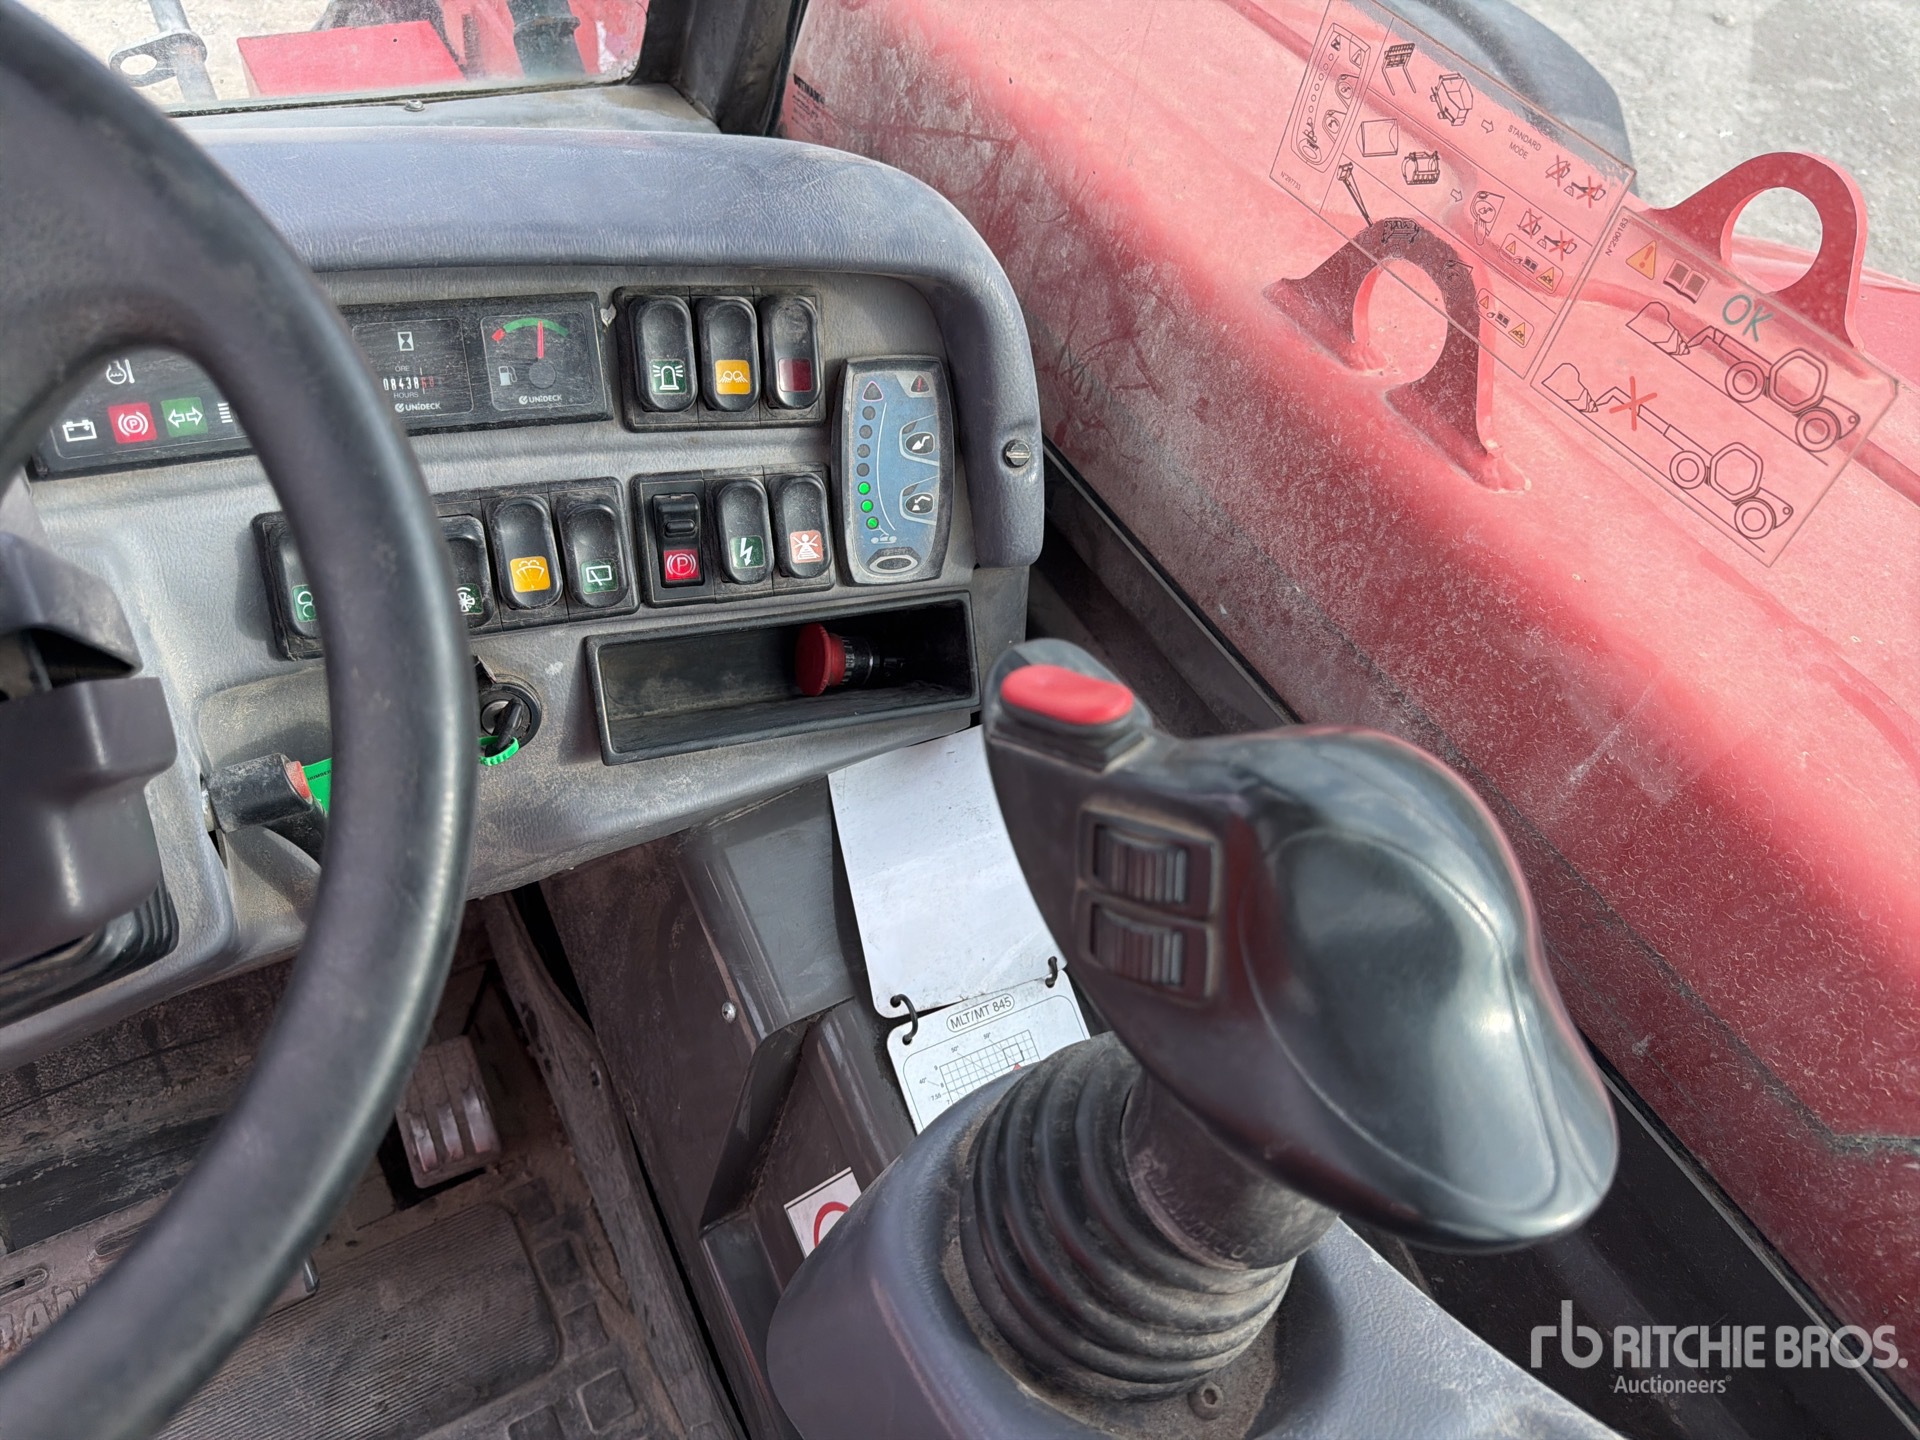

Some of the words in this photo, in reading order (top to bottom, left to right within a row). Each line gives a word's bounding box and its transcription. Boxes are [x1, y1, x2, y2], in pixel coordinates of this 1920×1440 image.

[1508, 124, 1542, 151] STANDARD
[1509, 141, 1529, 160] MODE
[1722, 293, 1774, 342] OK
[393, 391, 419, 399] HOURS
[949, 1004, 991, 1030] MLT/MT
[992, 996, 1012, 1013] 845
